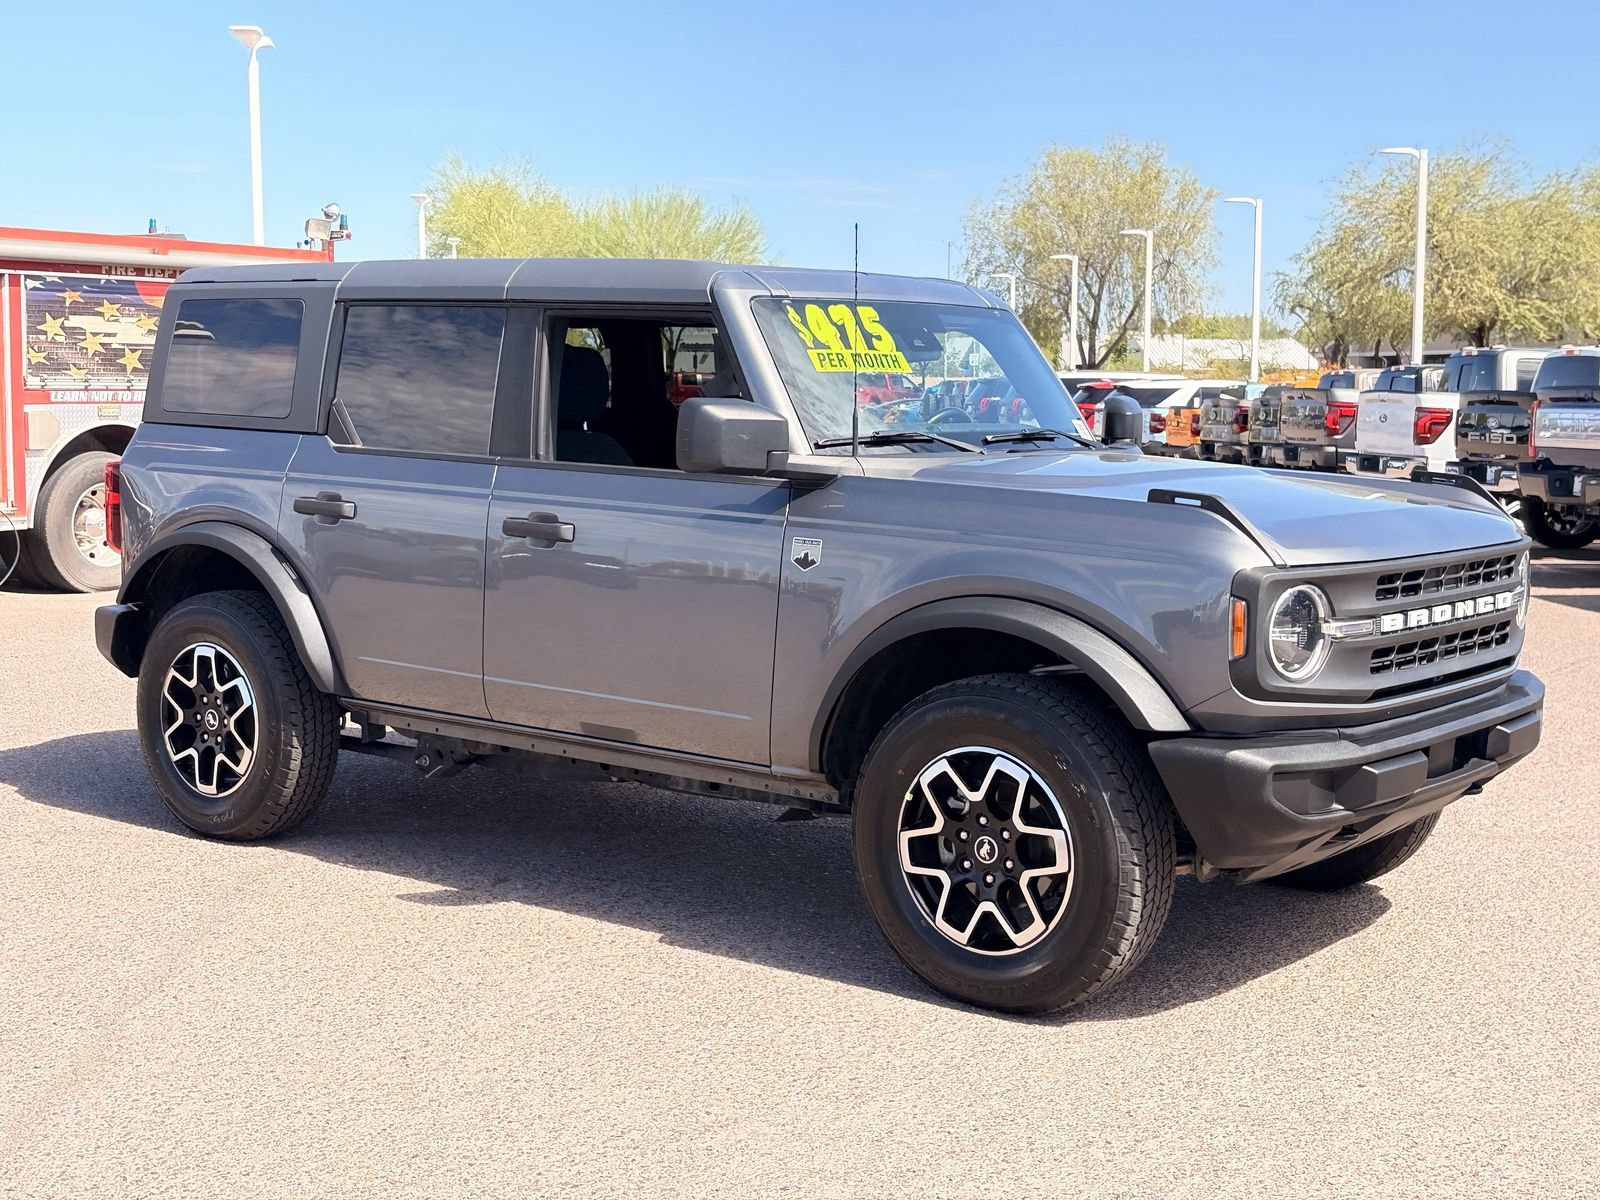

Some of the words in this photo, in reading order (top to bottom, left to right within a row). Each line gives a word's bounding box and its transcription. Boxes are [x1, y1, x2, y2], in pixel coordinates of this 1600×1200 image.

[102, 265, 136, 276] FIRE
[786, 303, 897, 352] $475
[817, 352, 847, 368] PER
[853, 353, 902, 369] MONTH
[50, 391, 88, 402] LEARN
[91, 391, 115, 402] NOT
[117, 391, 132, 402] TO
[1468, 432, 1517, 444] F-150
[1380, 591, 1512, 633] BRONCO
